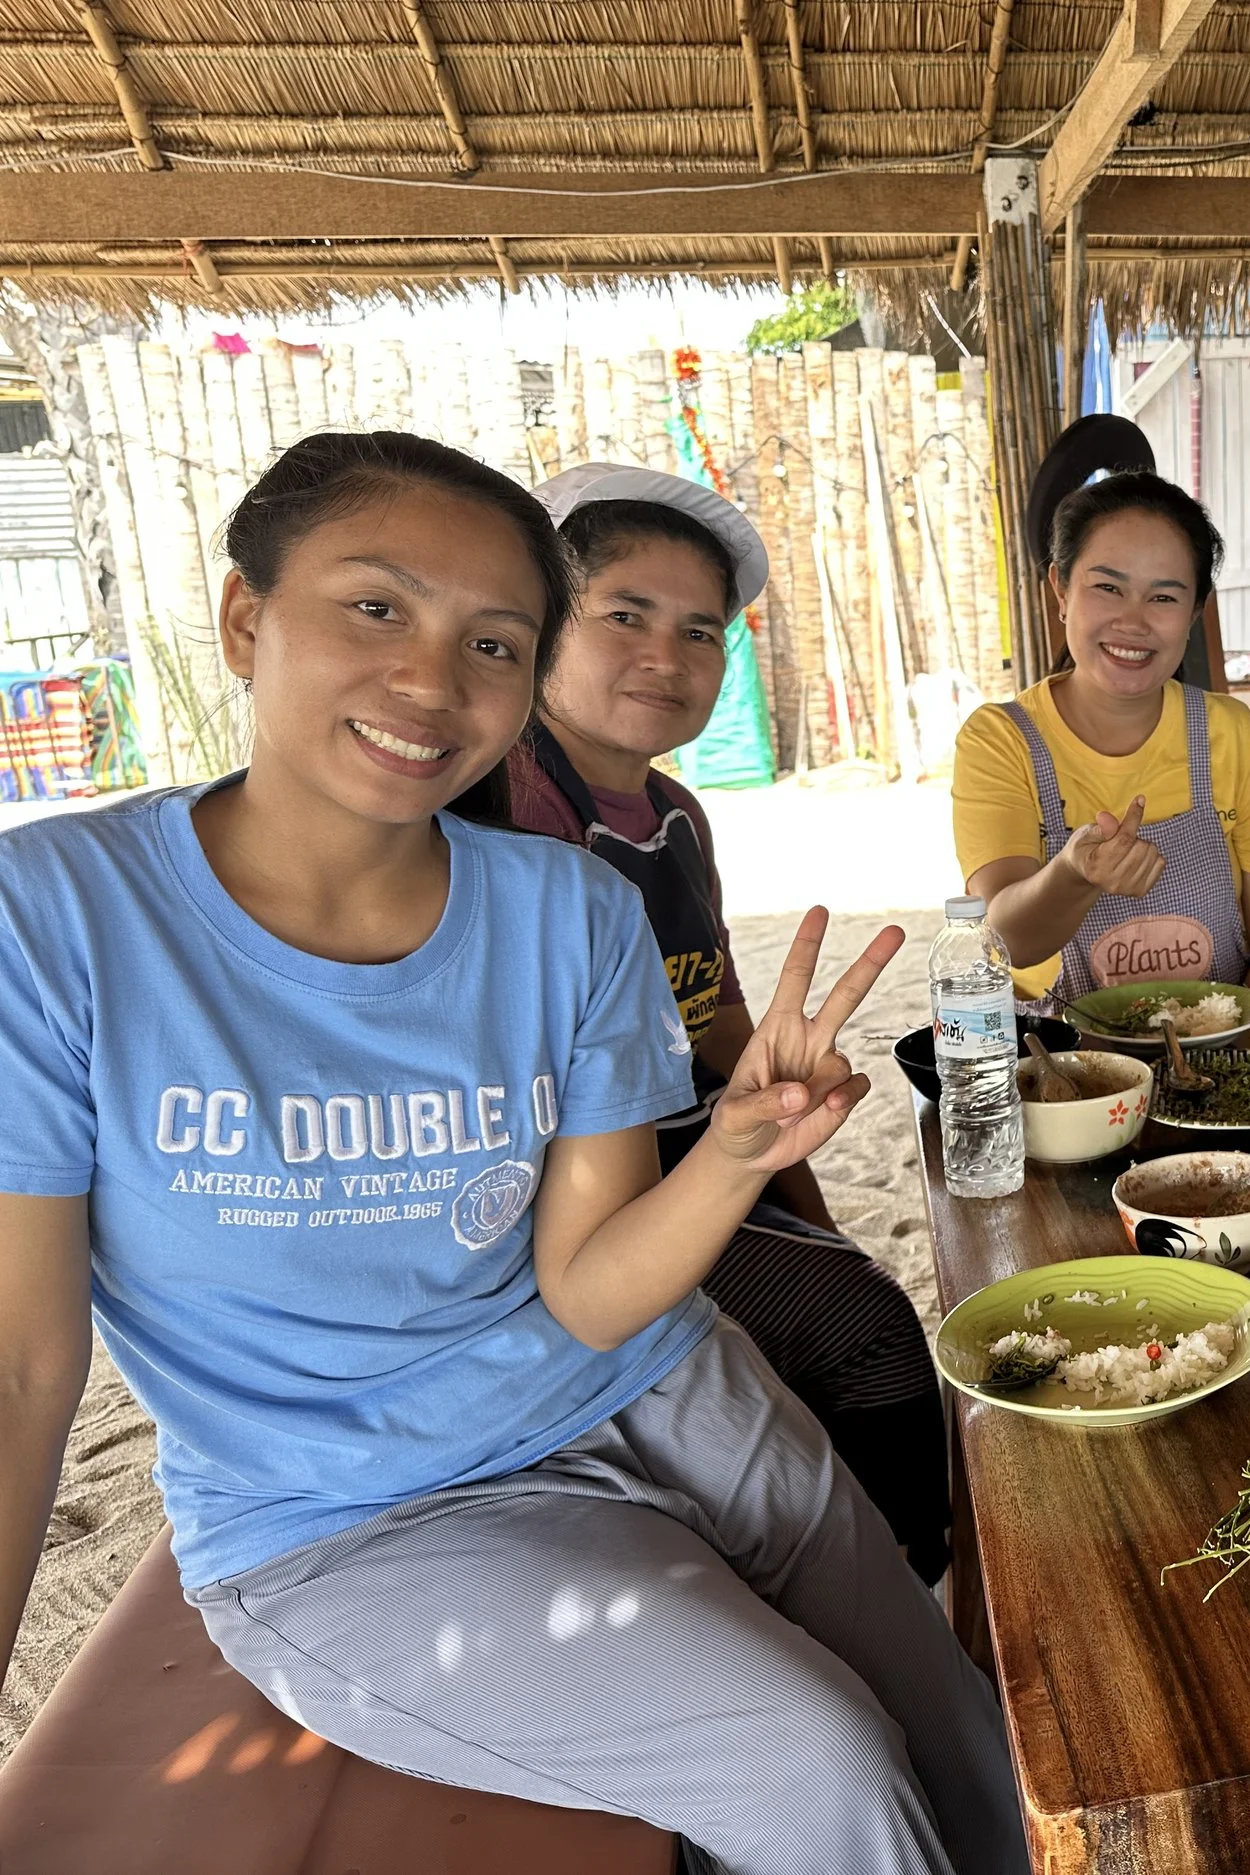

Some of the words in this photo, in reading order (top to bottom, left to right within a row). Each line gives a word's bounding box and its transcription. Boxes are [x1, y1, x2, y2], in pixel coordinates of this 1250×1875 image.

[1106, 939, 1202, 977] Plants
[156, 1085, 250, 1157] CC
[280, 1084, 511, 1163] DOUBLE
[532, 1073, 558, 1136] O
[169, 1168, 324, 1201] AMERICAN
[341, 1167, 459, 1199] VINTAGE
[217, 1206, 300, 1228] RUGGED
